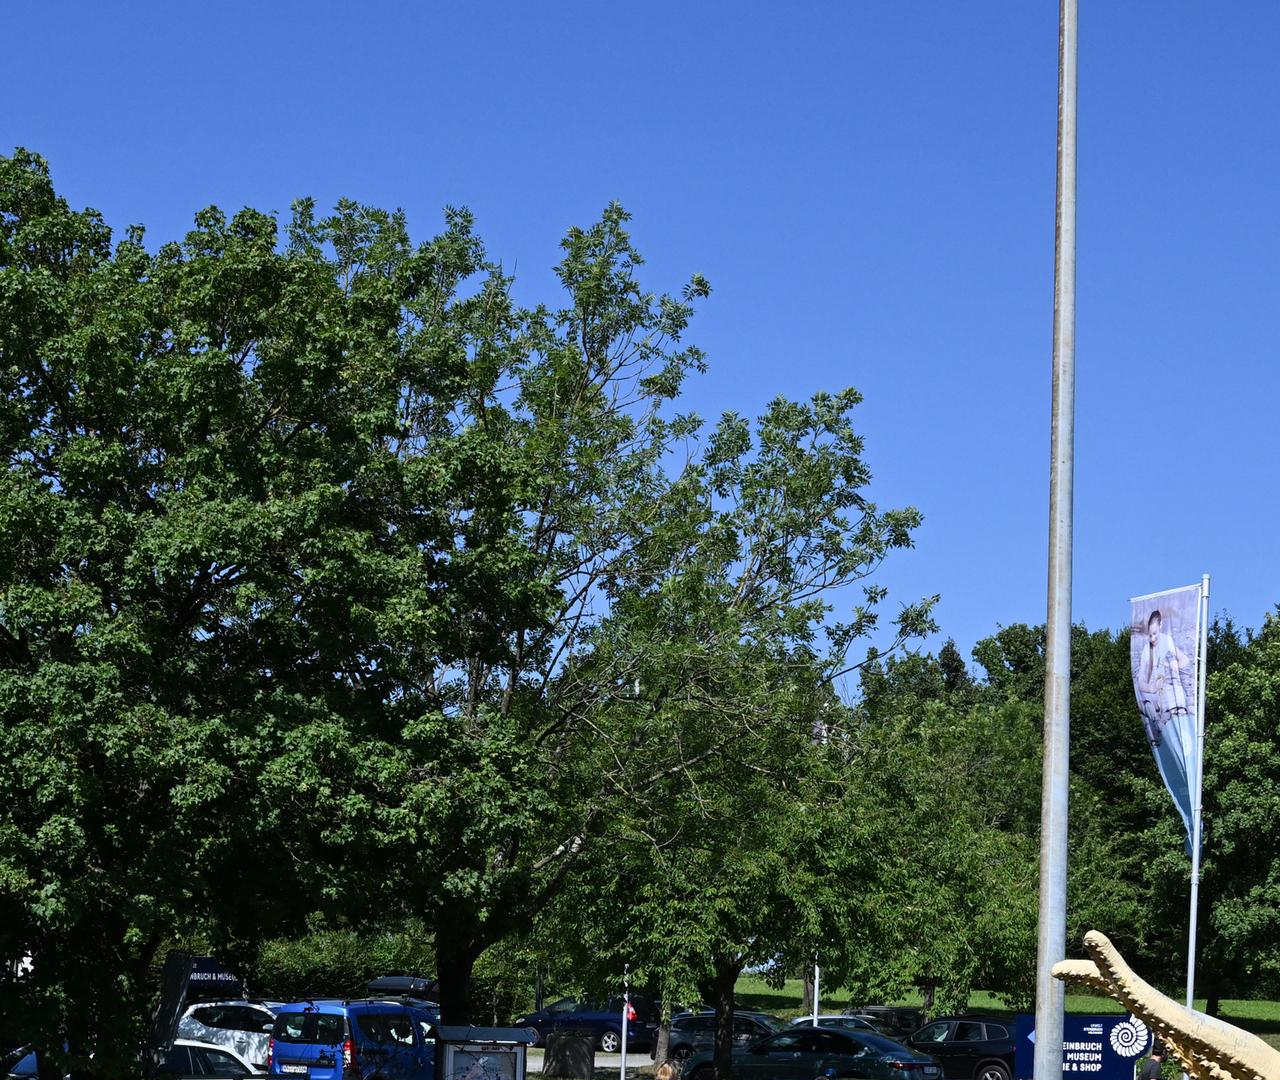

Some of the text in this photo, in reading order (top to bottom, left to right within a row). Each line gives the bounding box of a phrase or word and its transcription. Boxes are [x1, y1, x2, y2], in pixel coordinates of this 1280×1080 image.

[1063, 1042, 1102, 1051] EINBRUCH
[1067, 1053, 1102, 1061] MUSEUM
[1072, 1063, 1078, 1071] &
[1080, 1063, 1102, 1072] SHOP
